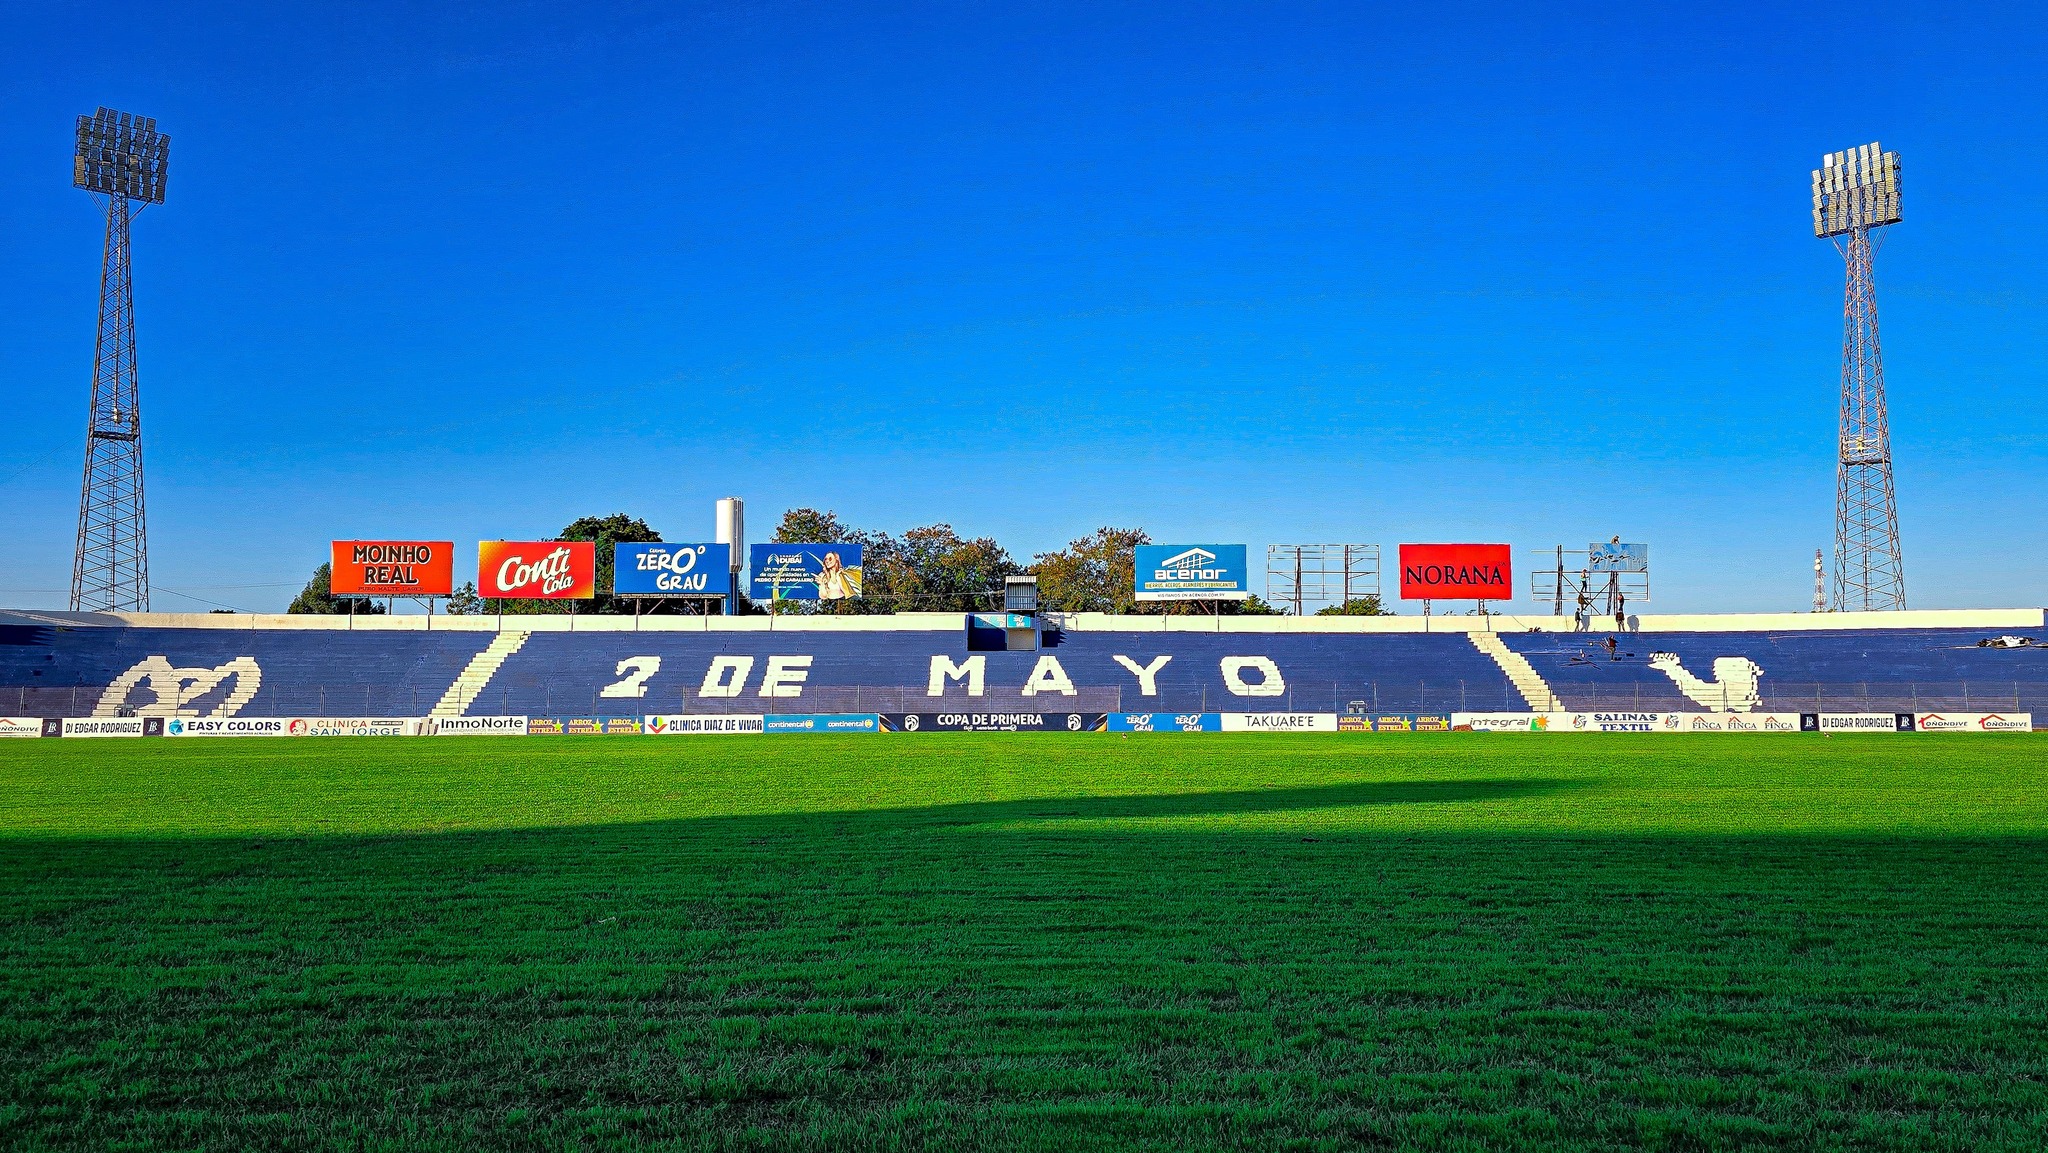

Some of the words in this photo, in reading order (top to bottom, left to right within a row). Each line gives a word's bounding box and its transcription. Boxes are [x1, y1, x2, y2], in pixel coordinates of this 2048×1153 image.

[352, 545, 432, 564] MOINHO
[364, 565, 419, 585] REAL
[496, 546, 571, 592] Conti
[1154, 569, 1228, 580] acenor
[656, 572, 708, 591] GRAU
[1405, 566, 1505, 585] NORANA
[542, 573, 575, 595] Cola
[600, 656, 662, 698] 2
[698, 656, 814, 698] DE
[926, 655, 1286, 697] MAYO
[187, 721, 224, 731] EASY
[227, 721, 281, 731] COLORS
[441, 717, 524, 729] InmoNorte
[670, 720, 702, 731] CLINICA
[704, 720, 722, 730] DIAZ
[726, 720, 736, 730] DE
[738, 720, 762, 730] VIVAR
[937, 714, 969, 726] COPA
[972, 714, 989, 725] DE
[992, 714, 1043, 725] PRIMERA
[1469, 718, 1530, 727] integral
[1831, 718, 1853, 727] EDGAR
[1856, 718, 1894, 728] RODRIGUEZ
[74, 723, 98, 733] EDGAR
[100, 722, 142, 733] RODRIGUEZ
